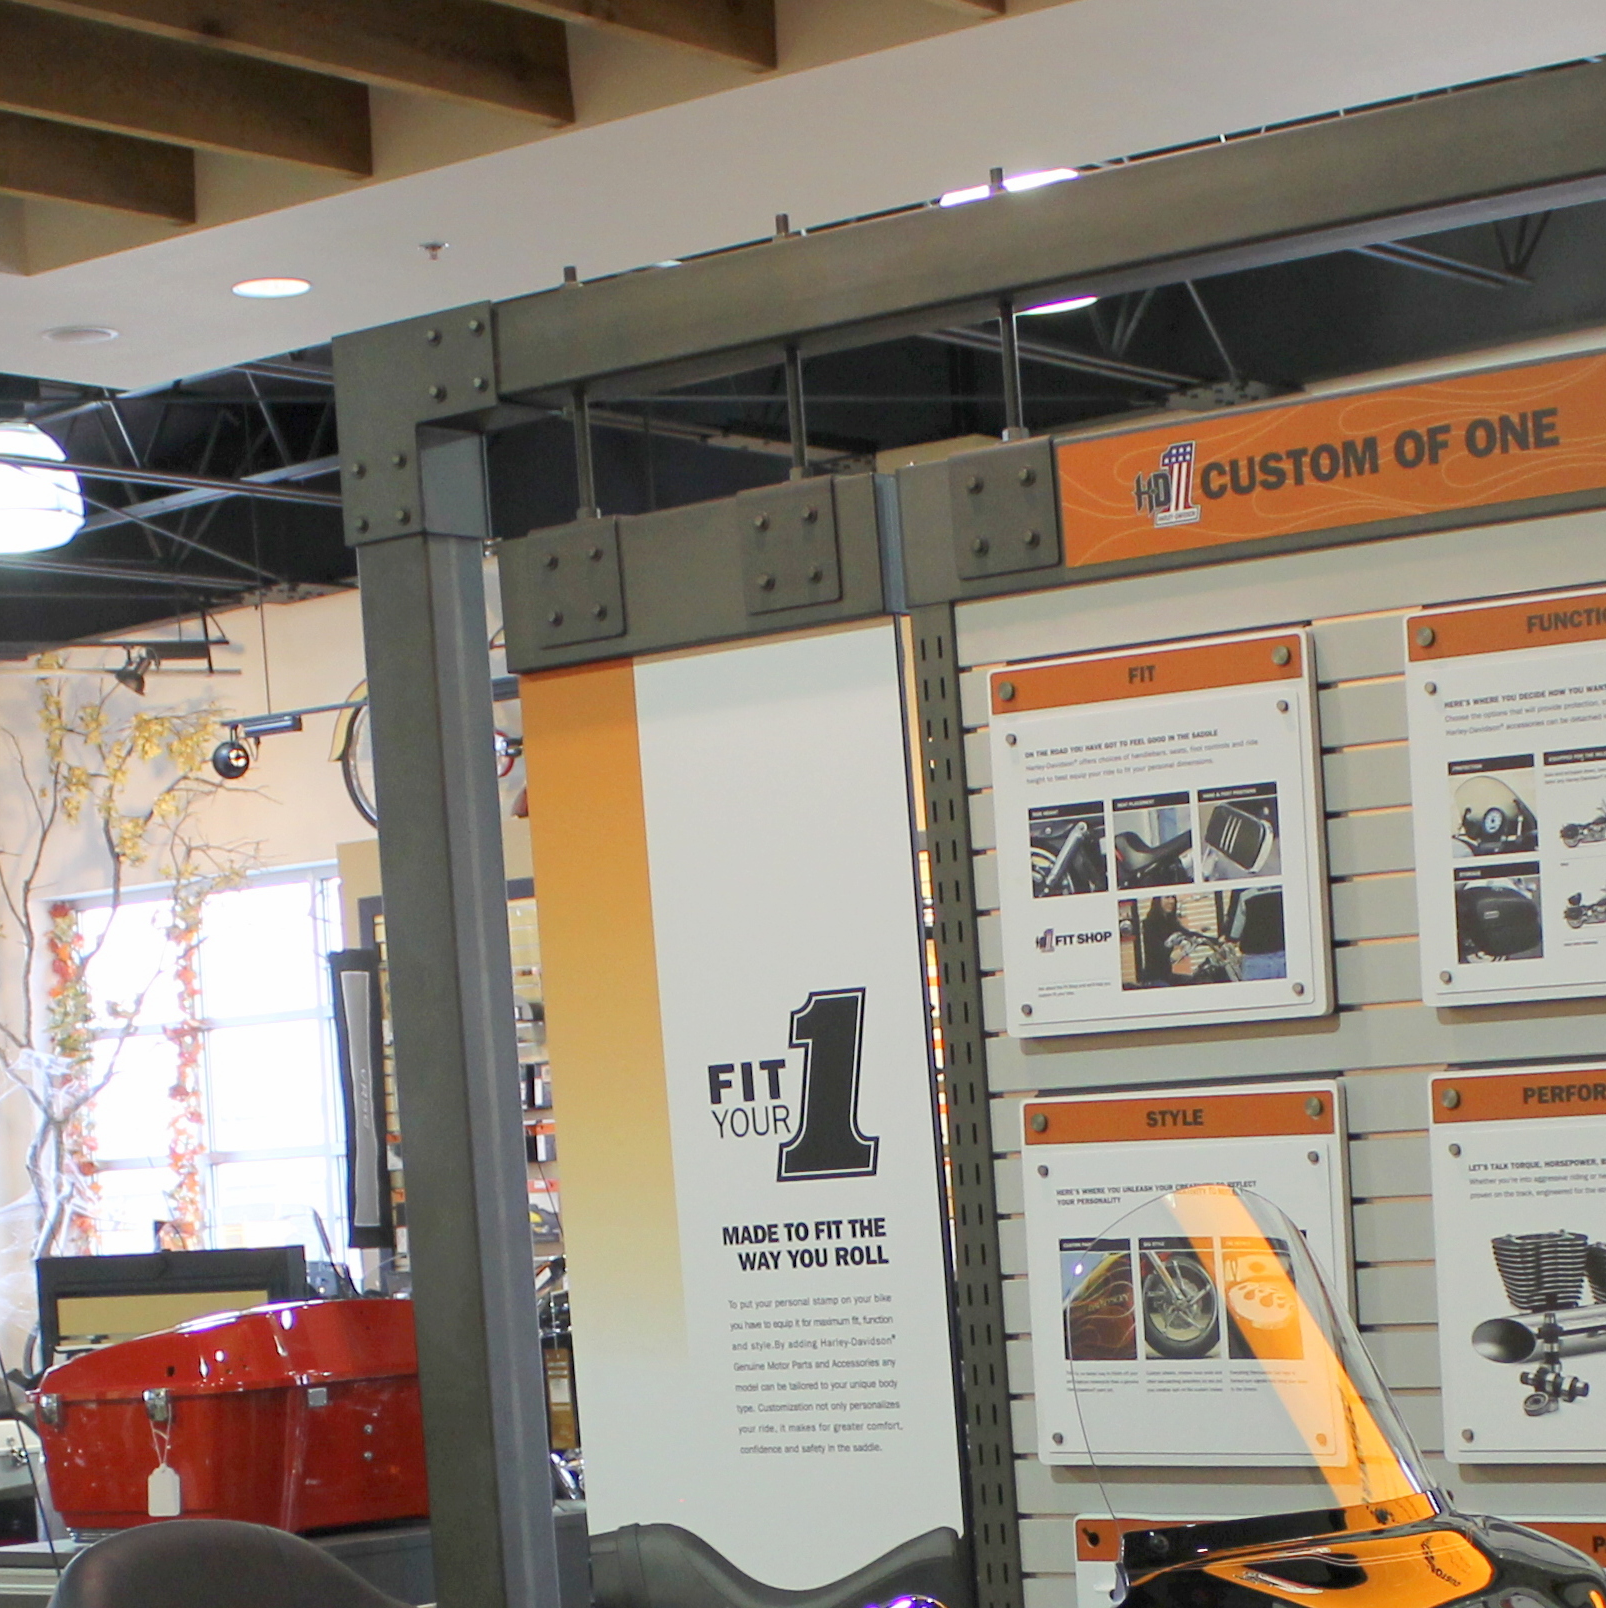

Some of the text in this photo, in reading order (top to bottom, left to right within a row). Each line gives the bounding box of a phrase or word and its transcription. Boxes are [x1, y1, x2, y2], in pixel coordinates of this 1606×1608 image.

[1199, 436, 1379, 501] CUSTOM
[1393, 424, 1451, 469] OF
[1464, 407, 1559, 459] ONE
[1128, 665, 1156, 684] FIT
[1055, 931, 1112, 946] FIT SHOP
[707, 1058, 787, 1105] FIT
[711, 1105, 792, 1139] YOUR
[1146, 1109, 1205, 1128] STYLE
[723, 1217, 886, 1246] MADE TO FIT THE
[738, 1245, 889, 1271] WAY YOU ROLL
[728, 1293, 892, 1310] To put your personal stamp on your bike
[733, 1358, 896, 1371] Genuine Motor Parts and Accessories any
